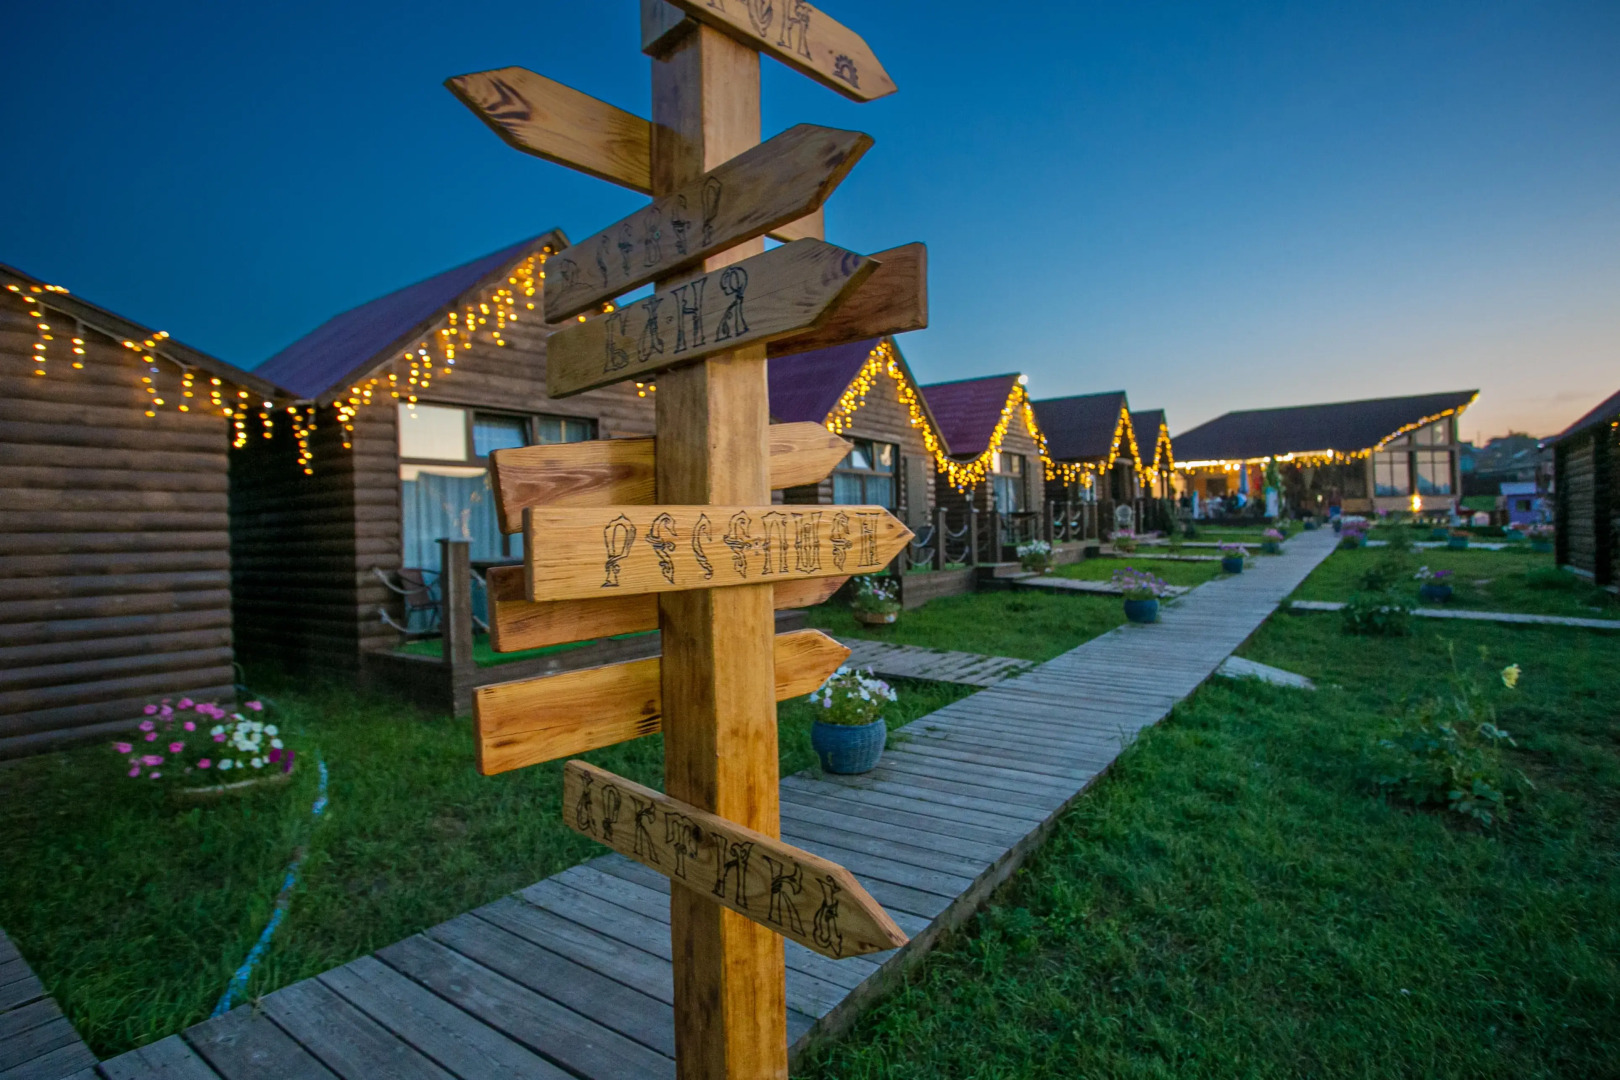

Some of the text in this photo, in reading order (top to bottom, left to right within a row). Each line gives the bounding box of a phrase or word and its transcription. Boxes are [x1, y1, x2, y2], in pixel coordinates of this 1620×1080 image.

[705, 0, 813, 62] ОК
[603, 266, 750, 374] БАНЯ
[600, 510, 883, 588] РЕСЕПШЕН
[576, 770, 843, 957] АРКТИКА
